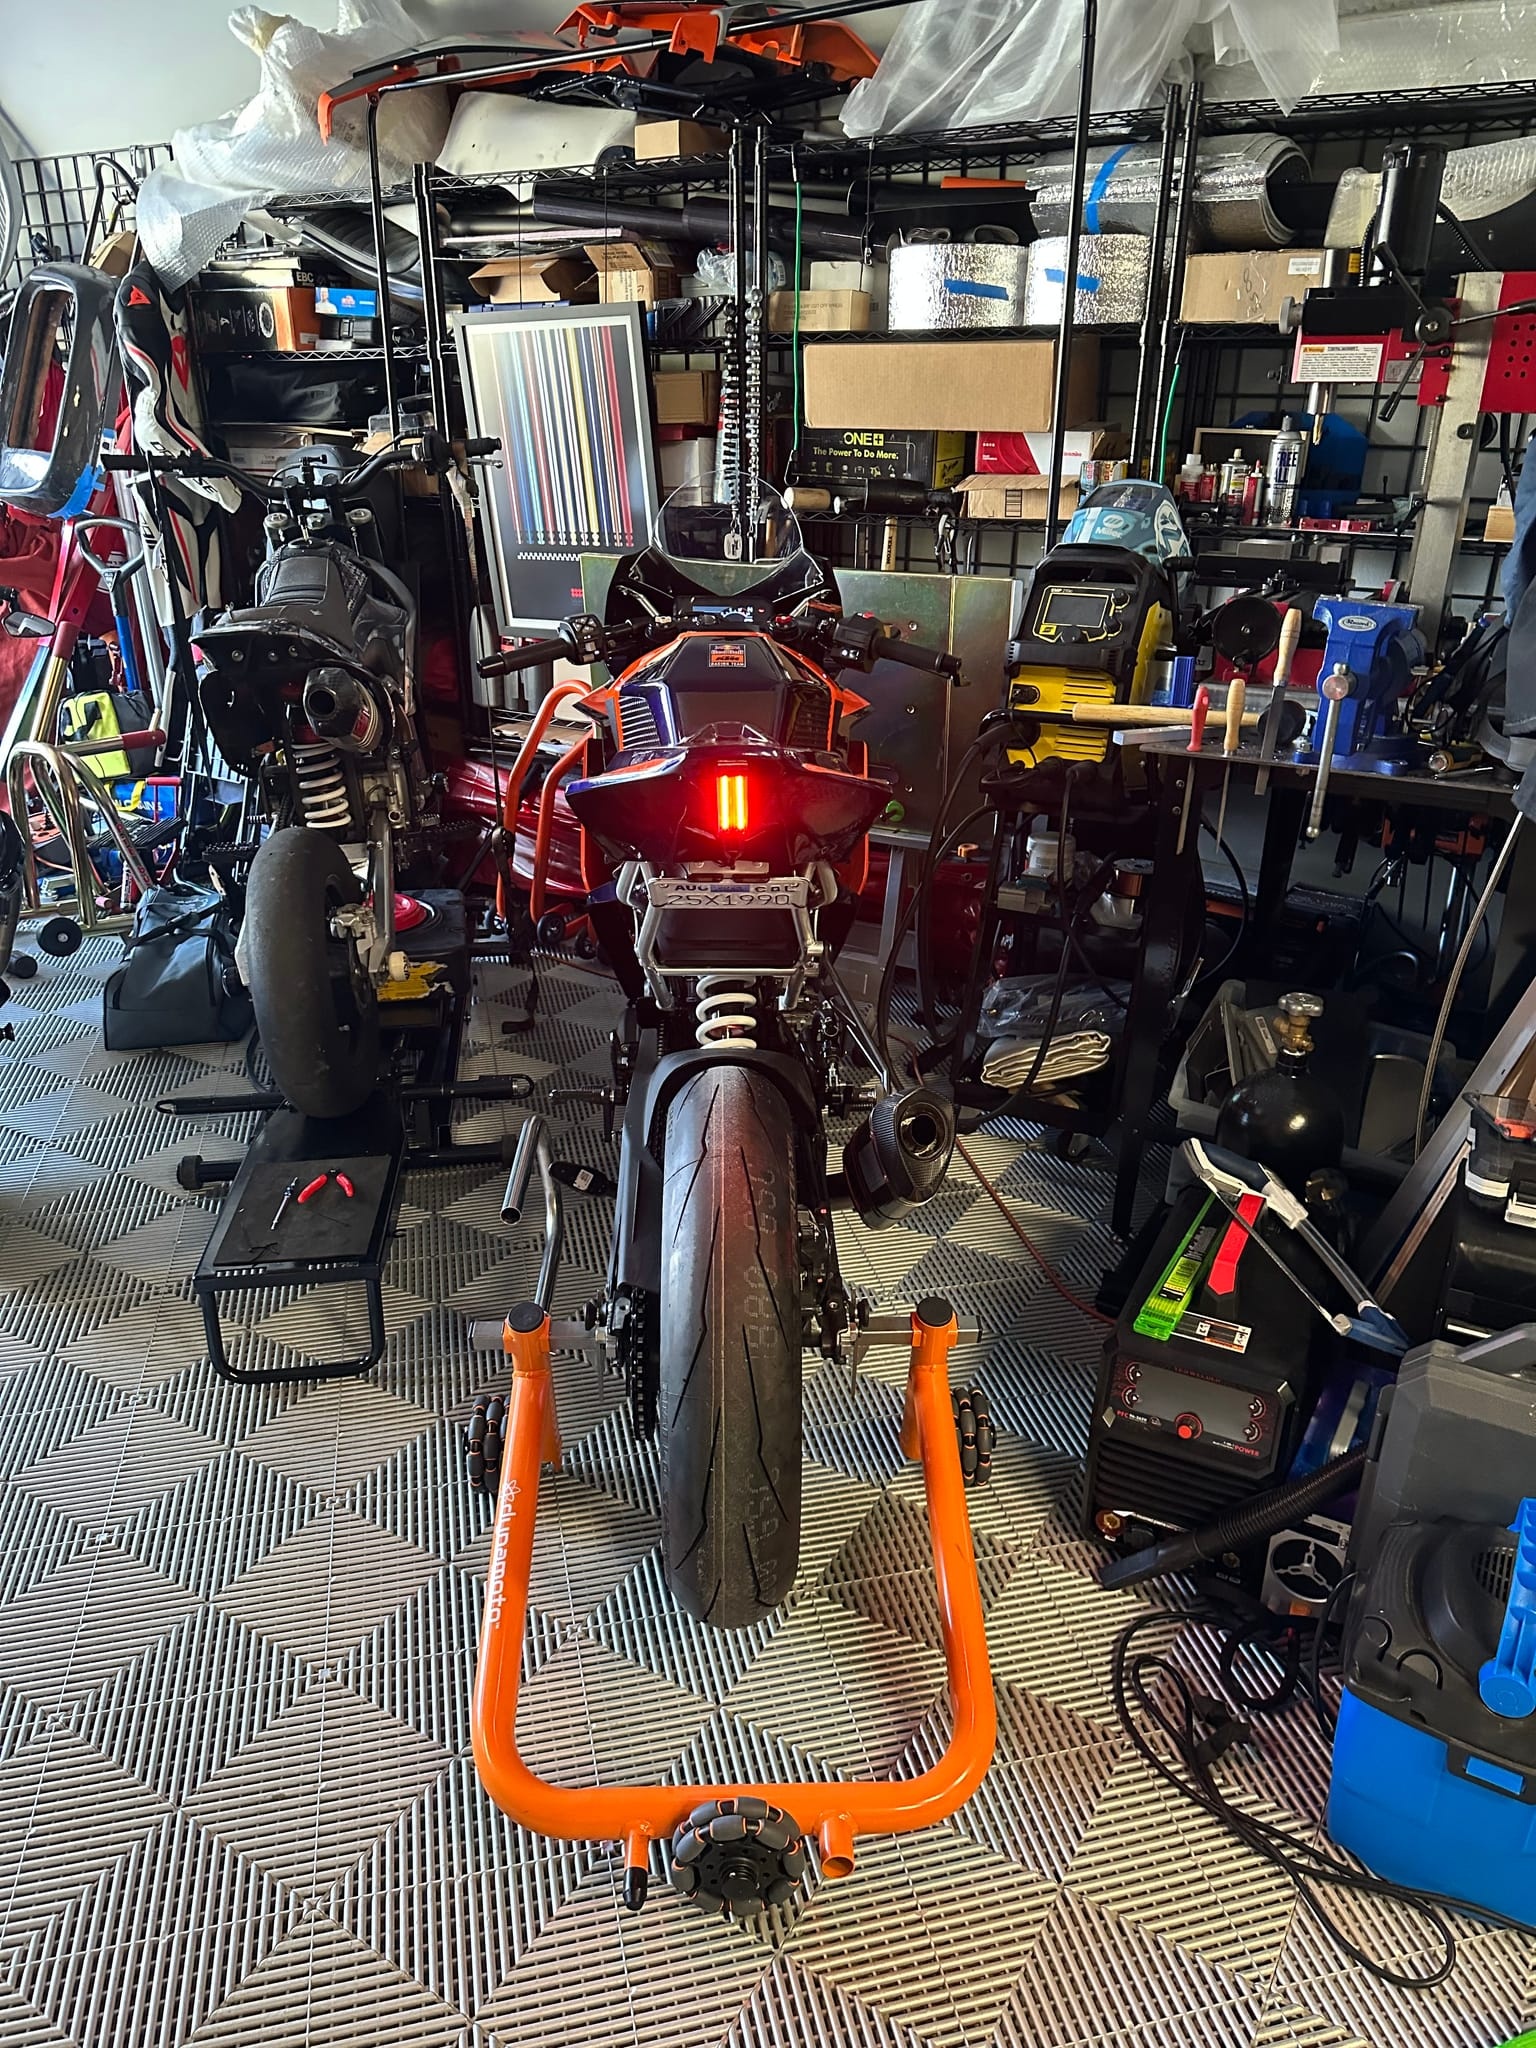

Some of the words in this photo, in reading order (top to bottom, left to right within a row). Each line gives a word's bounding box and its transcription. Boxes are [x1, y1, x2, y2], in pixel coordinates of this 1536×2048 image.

[296, 271, 314, 283] EBC
[813, 446, 827, 456] The
[828, 447, 851, 457] Power
[853, 448, 862, 458] To
[864, 449, 875, 459] Do
[1095, 526, 1122, 539] Miller
[667, 894, 791, 906] 25X1990
[1234, 1444, 1259, 1456] POWER
[488, 1504, 517, 1624] dynamoto
